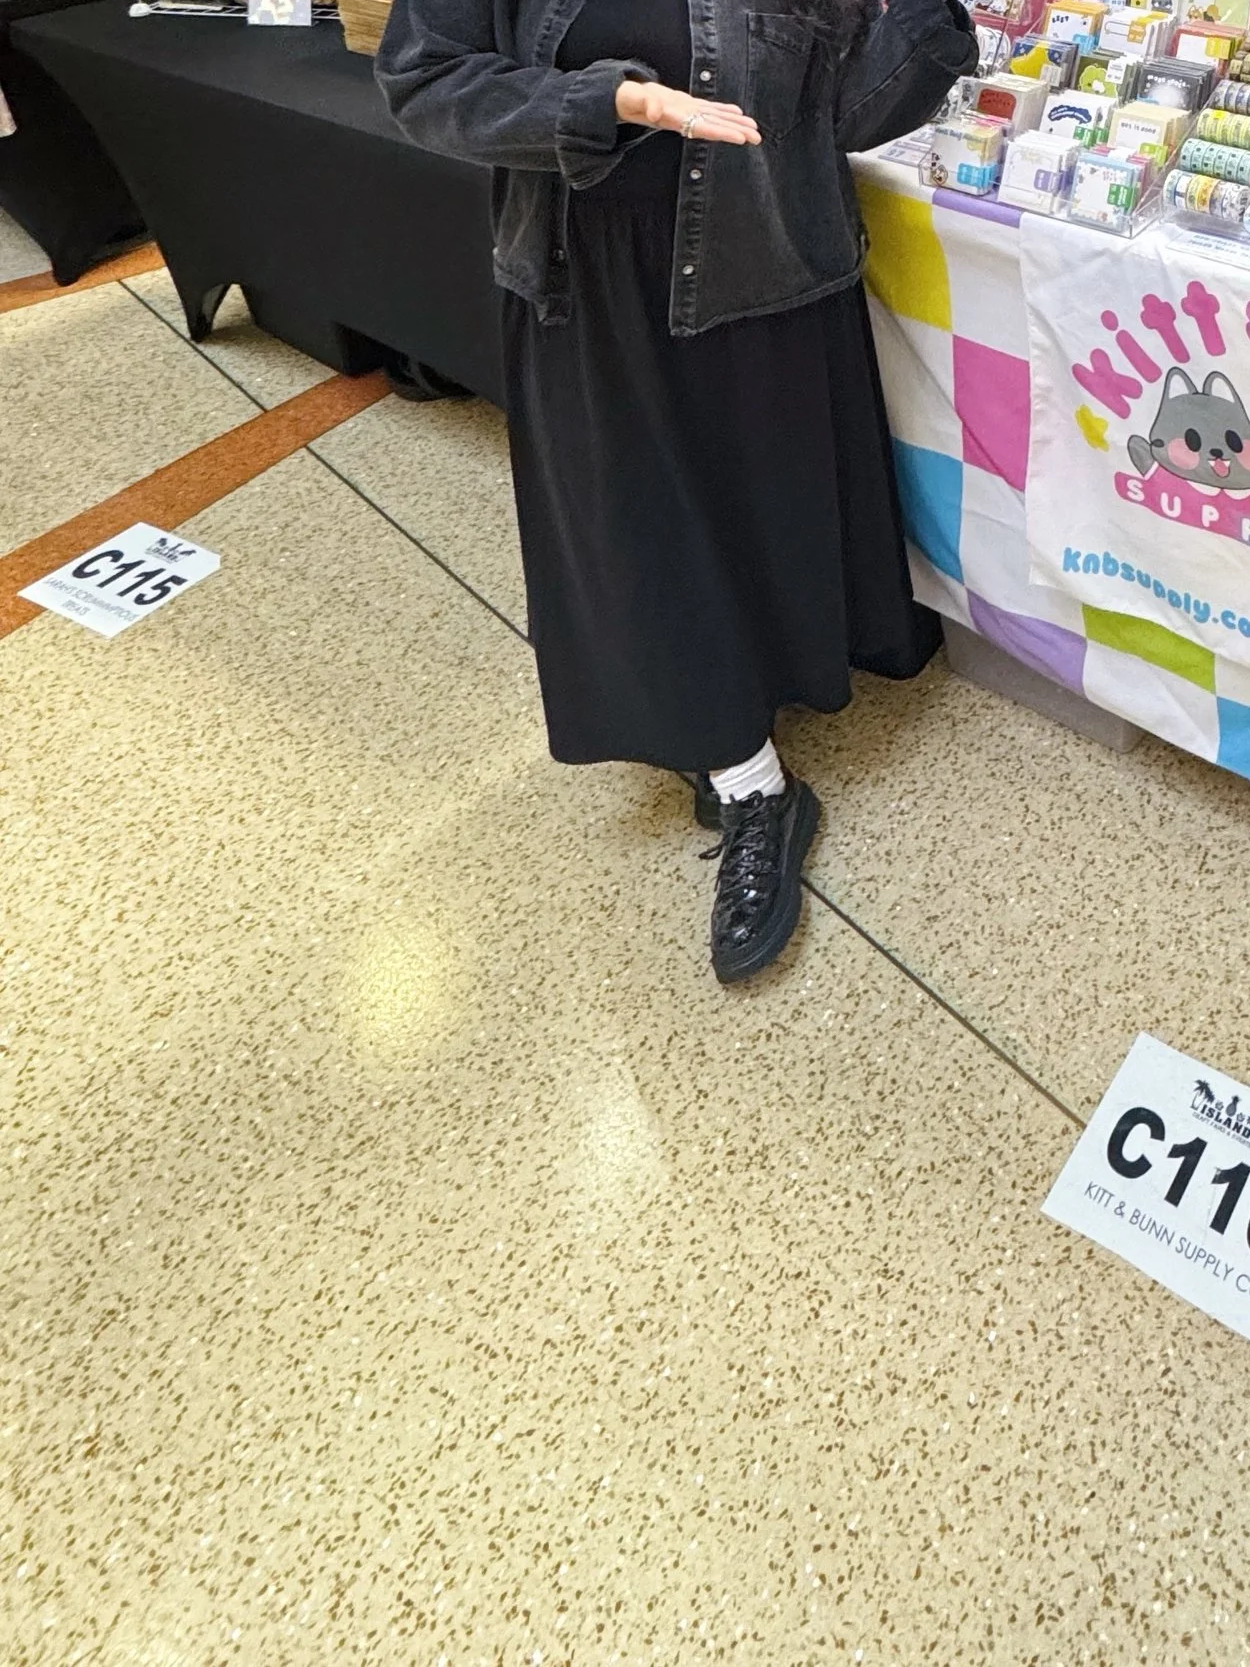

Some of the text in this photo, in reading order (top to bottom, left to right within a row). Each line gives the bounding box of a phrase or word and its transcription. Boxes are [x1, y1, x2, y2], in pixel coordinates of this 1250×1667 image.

[72, 549, 188, 606] C115
[1084, 1180, 1115, 1209] KITT
[1114, 1201, 1126, 1218] &
[1129, 1209, 1176, 1246] BUNN
[1175, 1237, 1235, 1282] SUPPLY
